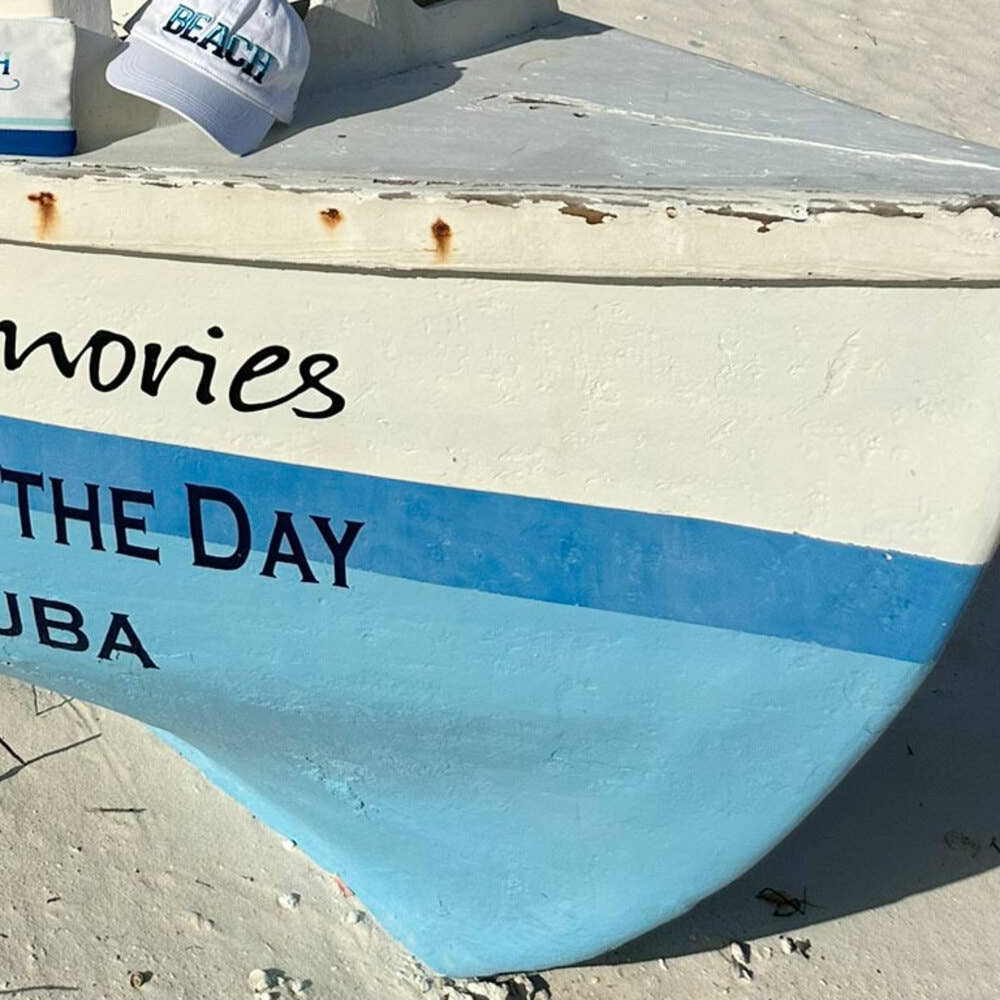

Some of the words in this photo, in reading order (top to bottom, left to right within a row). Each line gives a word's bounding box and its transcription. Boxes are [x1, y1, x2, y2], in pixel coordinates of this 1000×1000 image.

[161, 3, 276, 84] BEACH
[0, 464, 161, 565] THE
[184, 481, 366, 590] DAY
